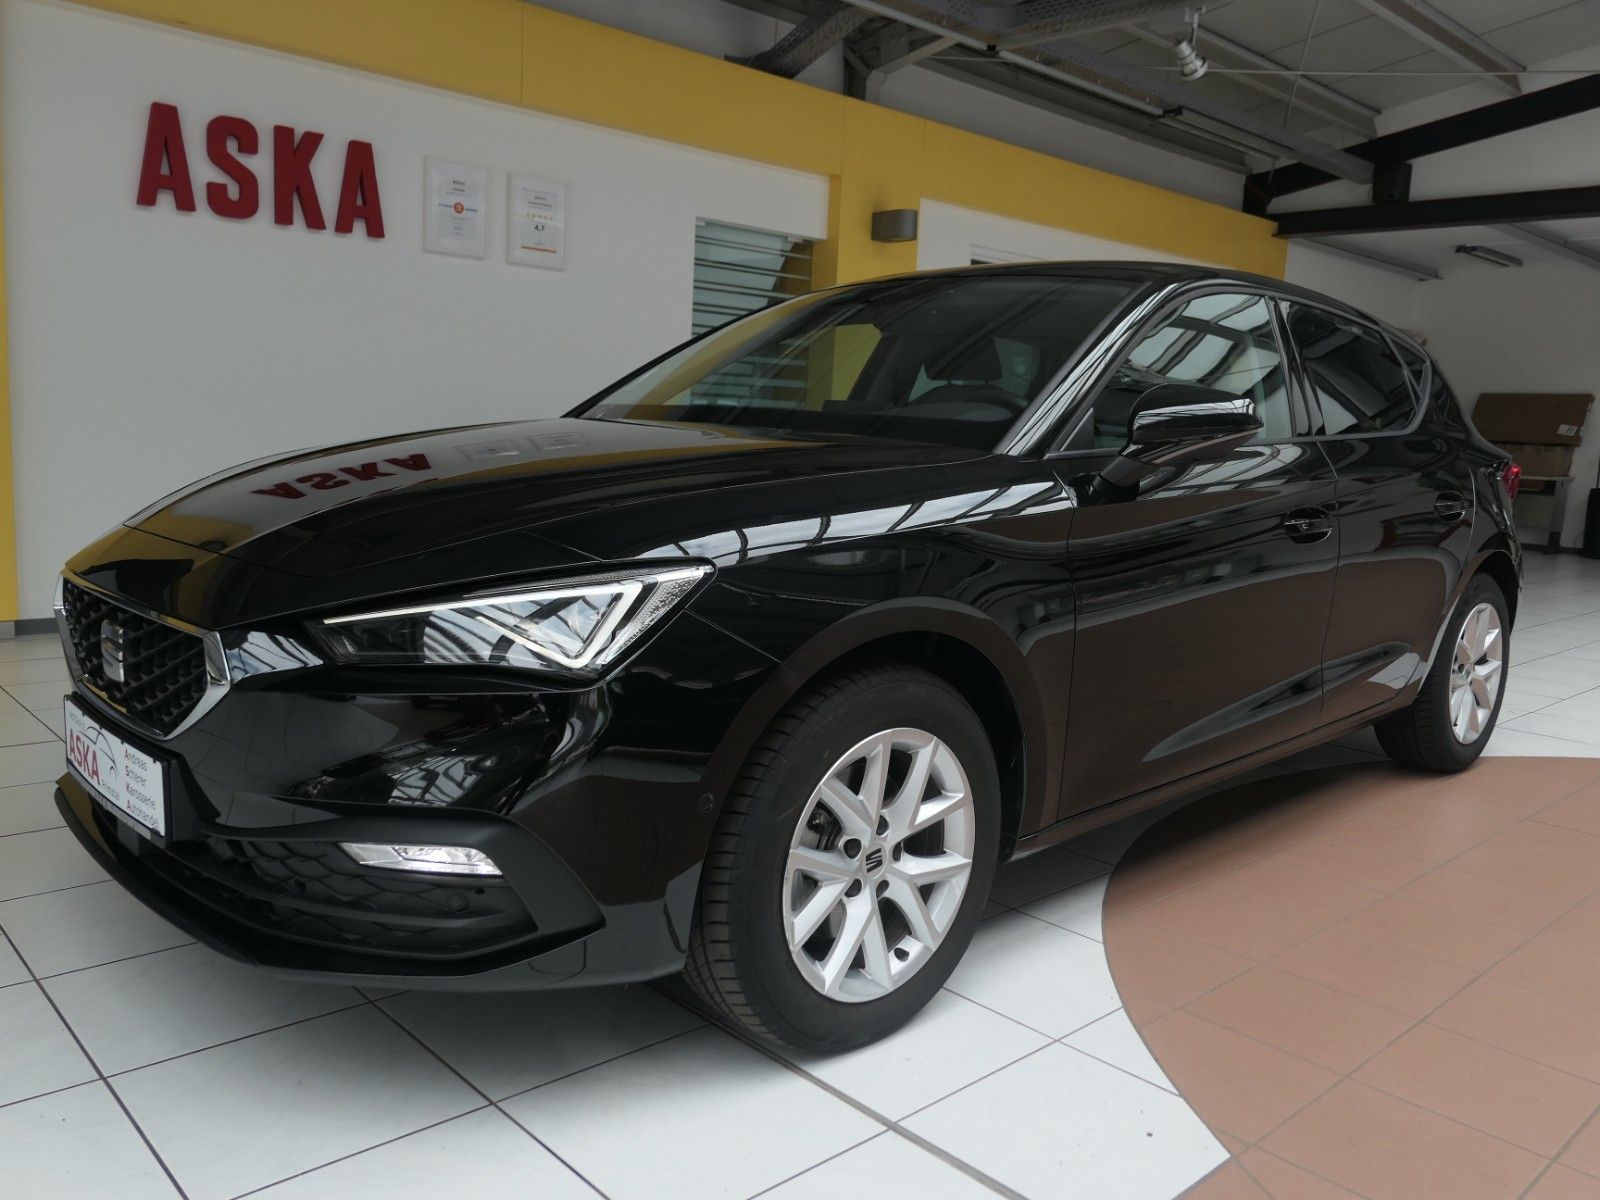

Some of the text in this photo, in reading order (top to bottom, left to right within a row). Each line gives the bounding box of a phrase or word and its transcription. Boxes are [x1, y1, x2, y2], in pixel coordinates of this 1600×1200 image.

[136, 101, 386, 240] ASKA
[69, 728, 101, 786] ASKA
[125, 781, 157, 810] Karosserie
